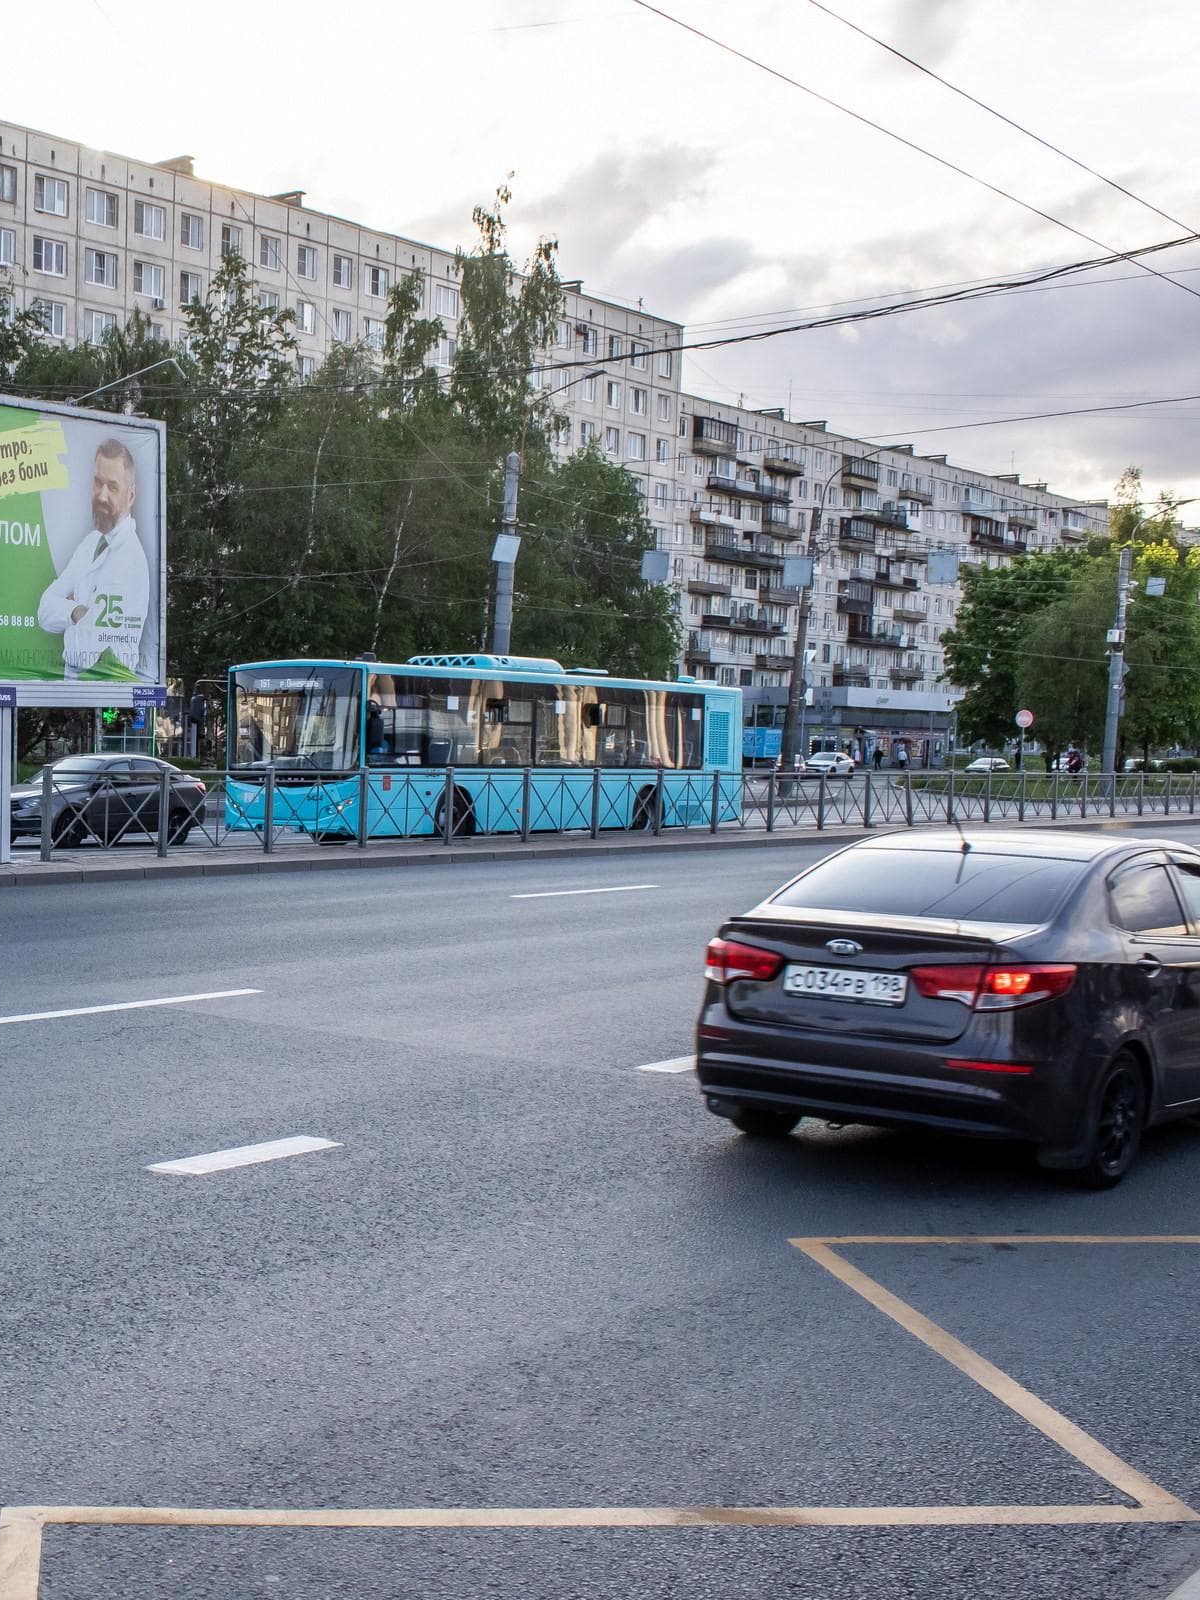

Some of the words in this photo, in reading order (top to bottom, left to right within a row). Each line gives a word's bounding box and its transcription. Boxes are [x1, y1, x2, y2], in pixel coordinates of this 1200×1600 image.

[19, 461, 48, 481] боли
[95, 594, 123, 628] 25
[11, 615, 22, 627] 88
[24, 615, 35, 627] 88
[98, 632, 138, 644] altermed.ru
[871, 975, 904, 993] 198
